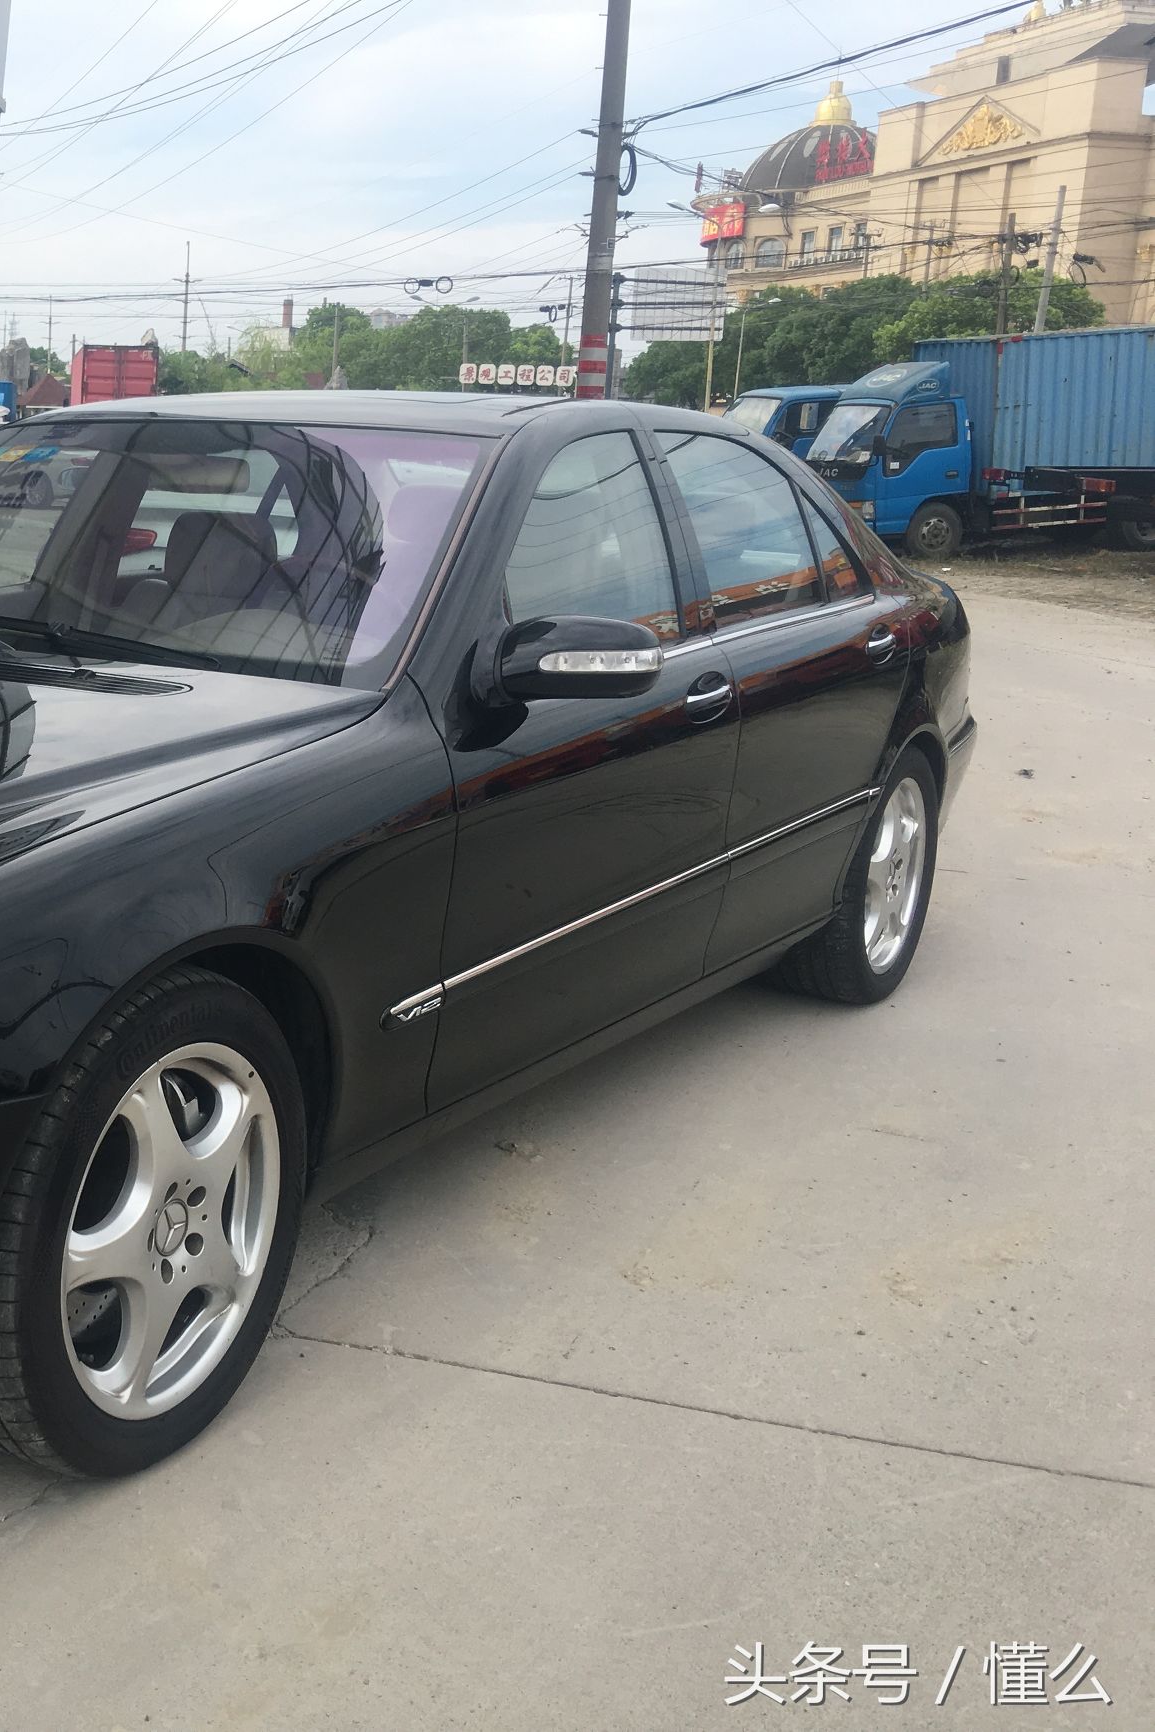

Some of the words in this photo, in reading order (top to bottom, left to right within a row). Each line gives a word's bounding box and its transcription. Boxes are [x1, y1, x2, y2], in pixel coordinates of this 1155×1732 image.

[460, 365, 572, 385] 景观工程公司
[818, 467, 839, 477] JAC
[396, 996, 442, 1022] V12
